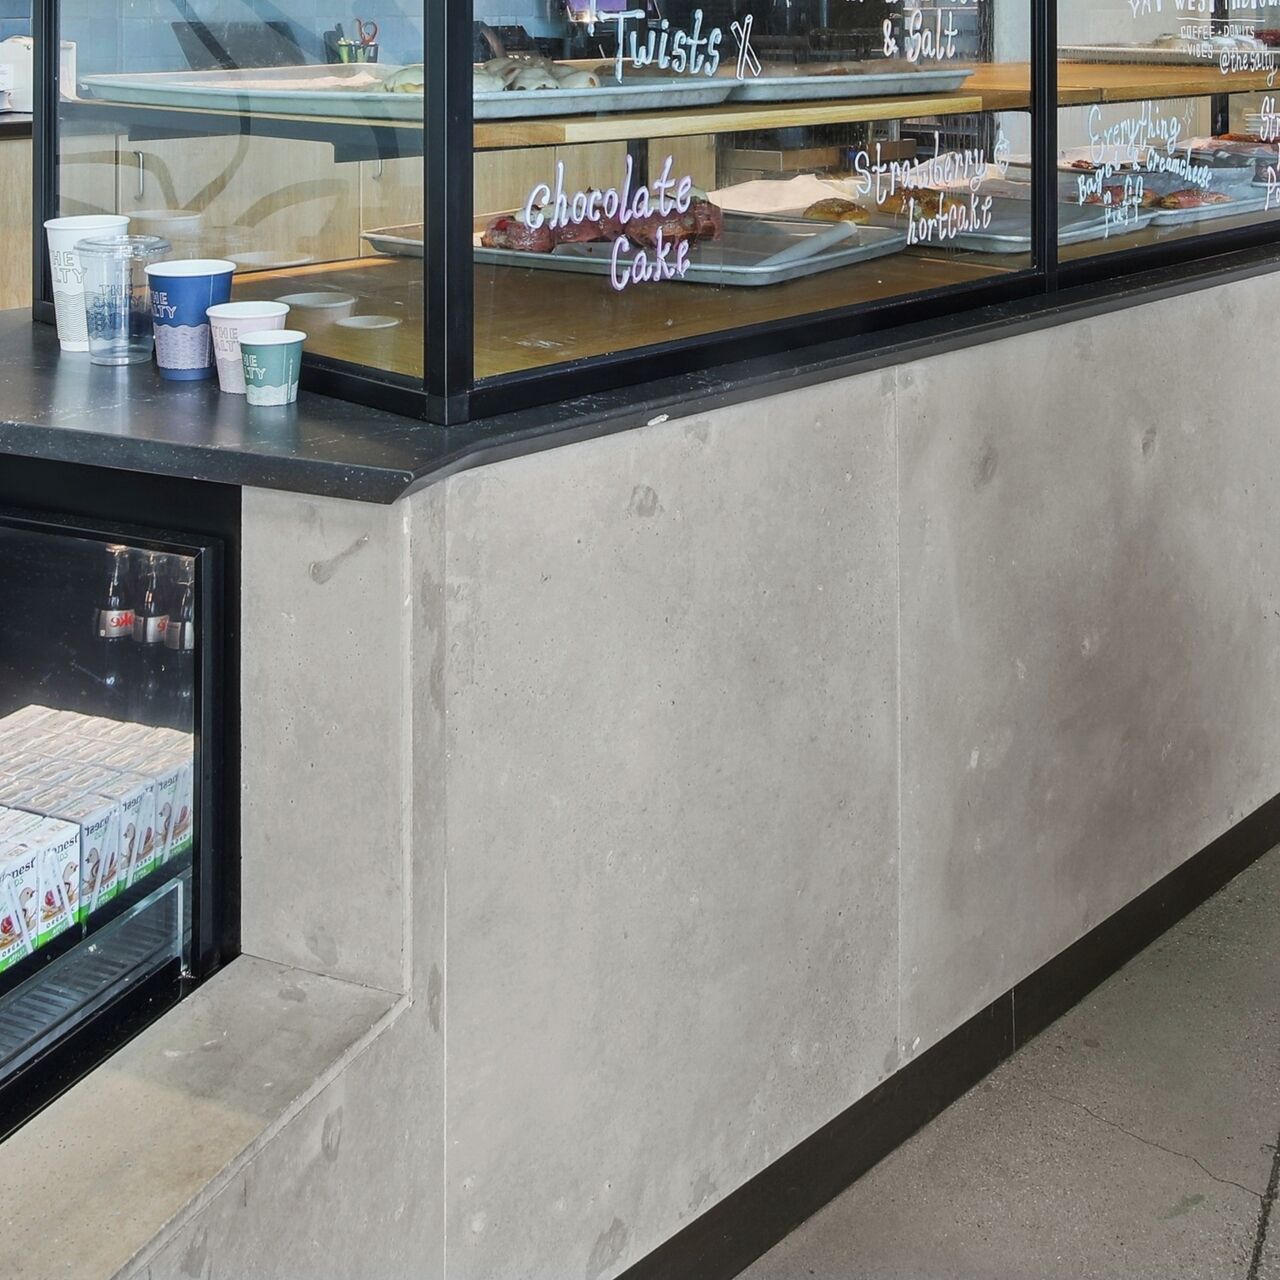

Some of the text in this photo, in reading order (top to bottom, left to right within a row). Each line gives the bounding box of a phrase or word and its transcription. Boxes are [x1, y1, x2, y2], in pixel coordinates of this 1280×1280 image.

[596, 8, 722, 83] Twists
[883, 9, 959, 62] & Salt
[1181, 25, 1215, 40] COFFEE
[1088, 100, 1181, 167] Everything
[523, 154, 694, 231] Chocolate
[854, 130, 989, 206] Strawberry
[902, 192, 994, 247] hortcake
[50, 251, 74, 266] HE
[608, 227, 692, 292] Cake
[151, 291, 169, 306] HE
[242, 354, 258, 367] HE
